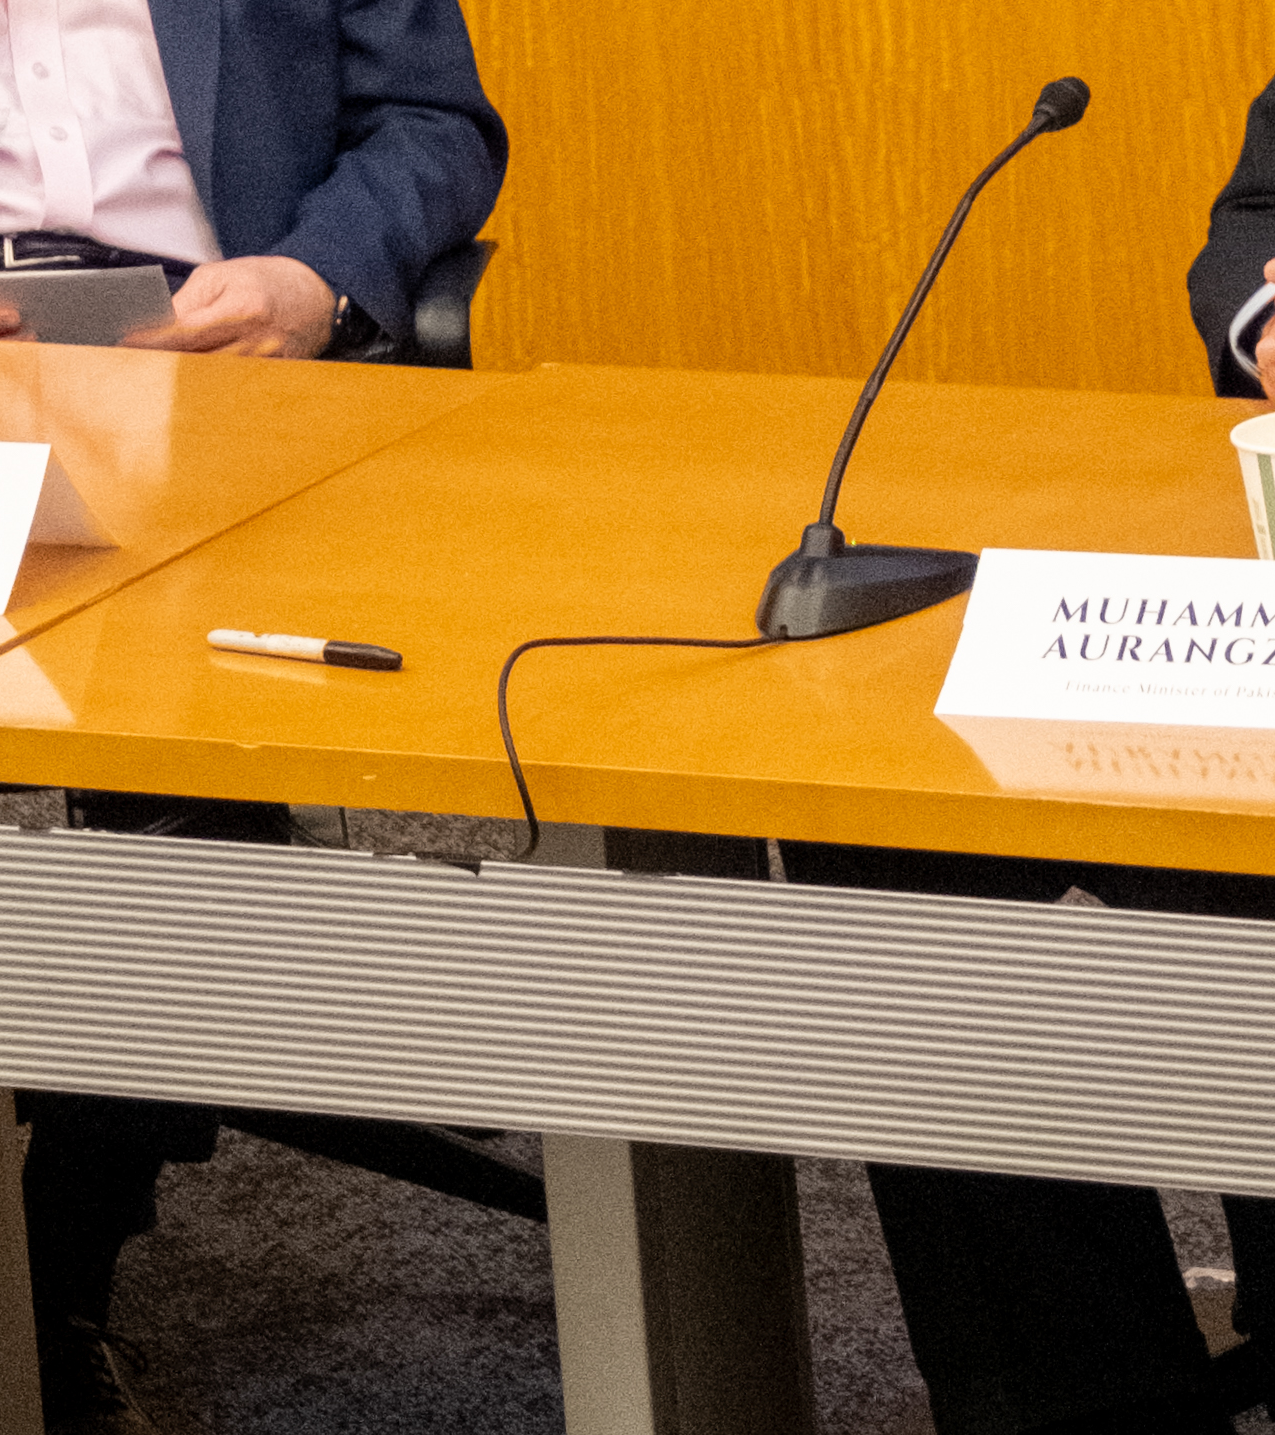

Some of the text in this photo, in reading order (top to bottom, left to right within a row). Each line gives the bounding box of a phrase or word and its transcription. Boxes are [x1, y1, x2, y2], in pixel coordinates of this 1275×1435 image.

[1064, 680, 1131, 695] Finance
[1137, 682, 1208, 697] Minister
[1213, 684, 1231, 697] of
